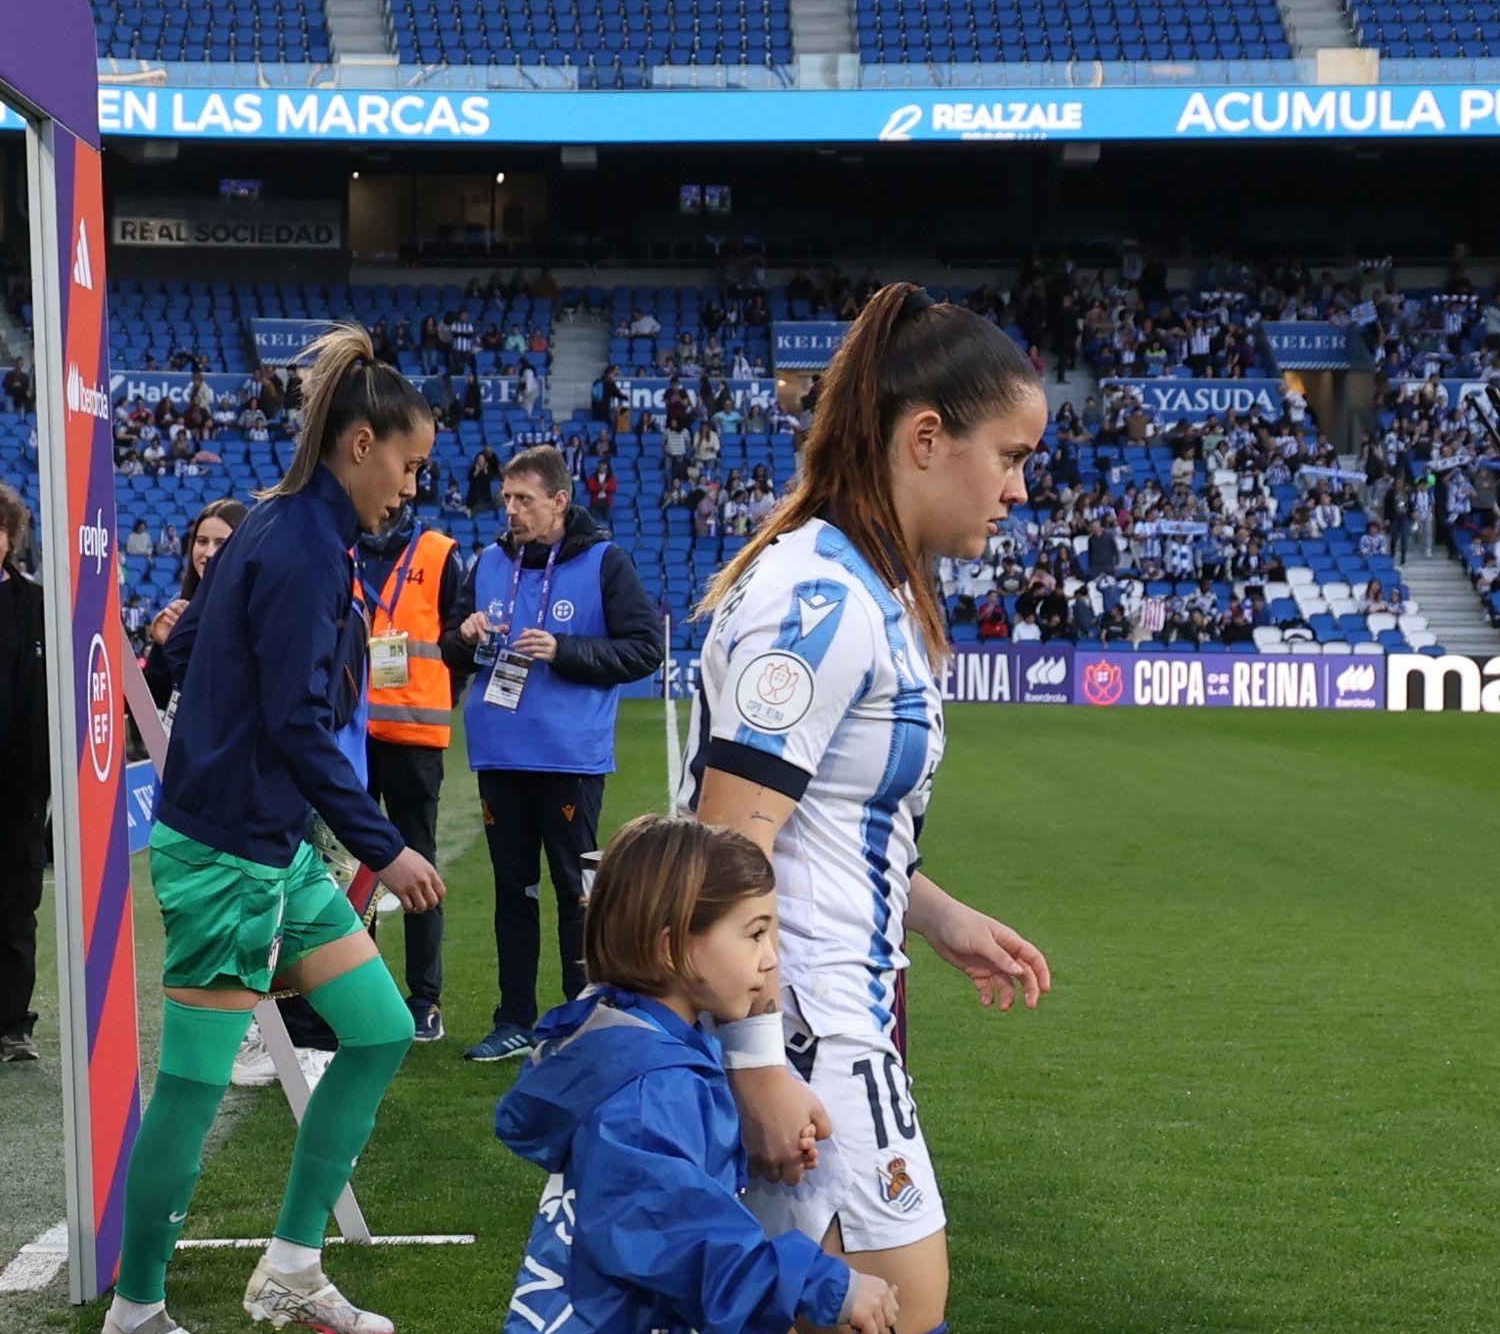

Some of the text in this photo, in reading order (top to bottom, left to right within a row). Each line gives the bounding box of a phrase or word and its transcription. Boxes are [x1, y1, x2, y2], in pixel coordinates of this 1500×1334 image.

[98, 91, 158, 130] EN
[172, 92, 263, 134] LAS
[276, 94, 491, 138] MARCAS
[931, 102, 1084, 130] REALZALE
[1175, 88, 1446, 134] ACUMULA
[120, 221, 333, 244] REAL SOCIEDAD
[255, 333, 319, 347] KELE
[78, 374, 110, 421] Iberdrola
[1152, 388, 1277, 413] YASUDA
[79, 509, 108, 574] renfe
[1134, 658, 1318, 708] COPA DE LA REINA
[851, 1052, 917, 1149] 10
